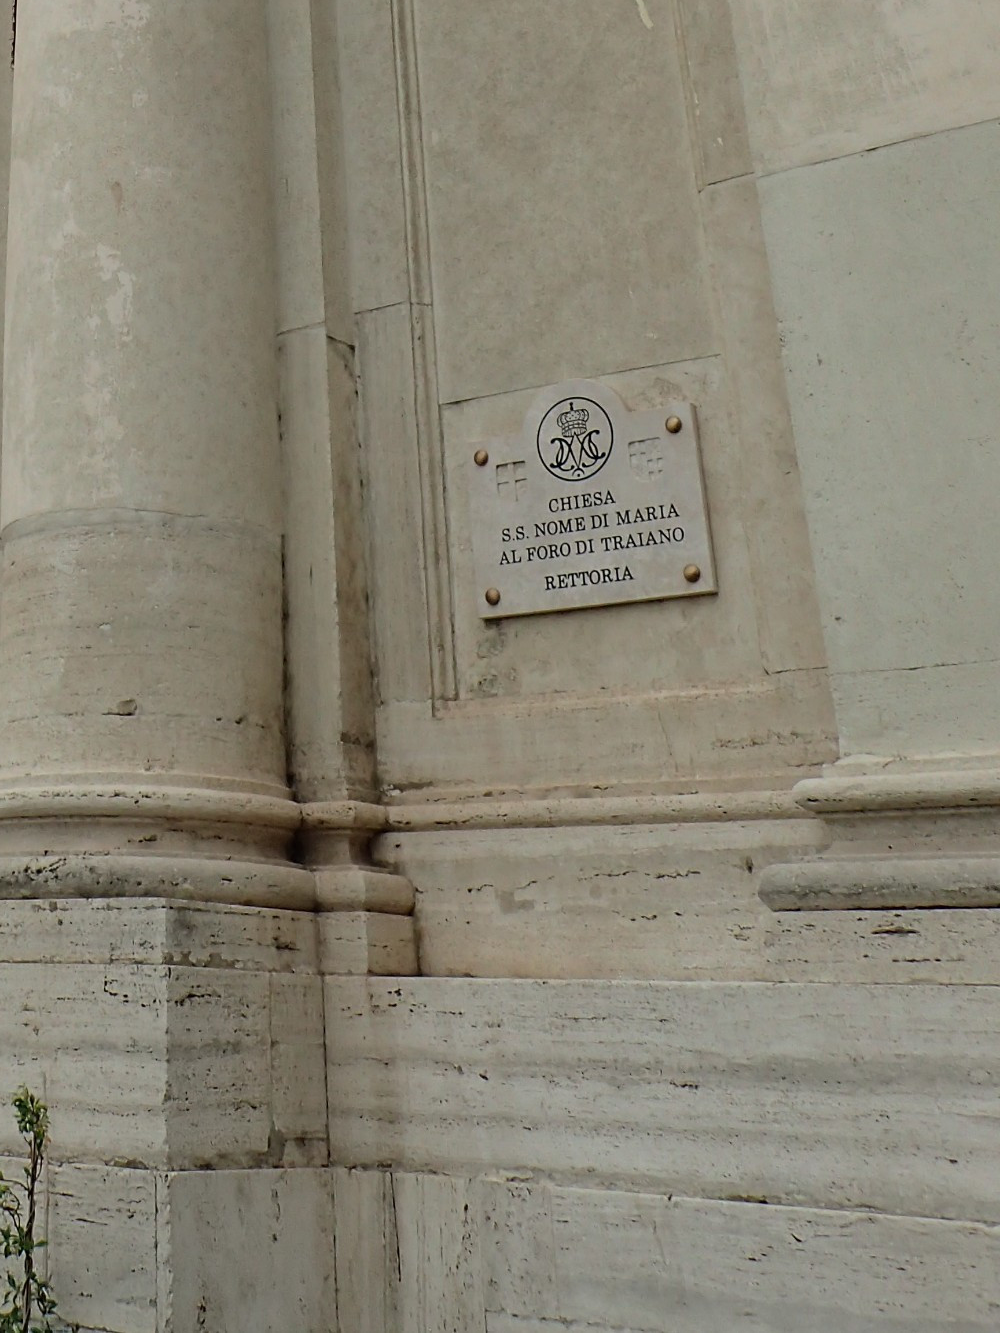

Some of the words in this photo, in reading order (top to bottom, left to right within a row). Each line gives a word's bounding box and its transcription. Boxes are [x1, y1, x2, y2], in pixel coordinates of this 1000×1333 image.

[548, 490, 617, 513] CHIESA
[501, 525, 529, 543] S.S.
[535, 516, 586, 538] NOME
[591, 513, 610, 529] DI
[616, 503, 680, 527] MARIA
[499, 549, 522, 566] AL
[527, 542, 571, 562] FORO
[576, 538, 595, 556] DI
[601, 526, 685, 553] TRAIANO
[544, 565, 634, 592] RETTORIA
